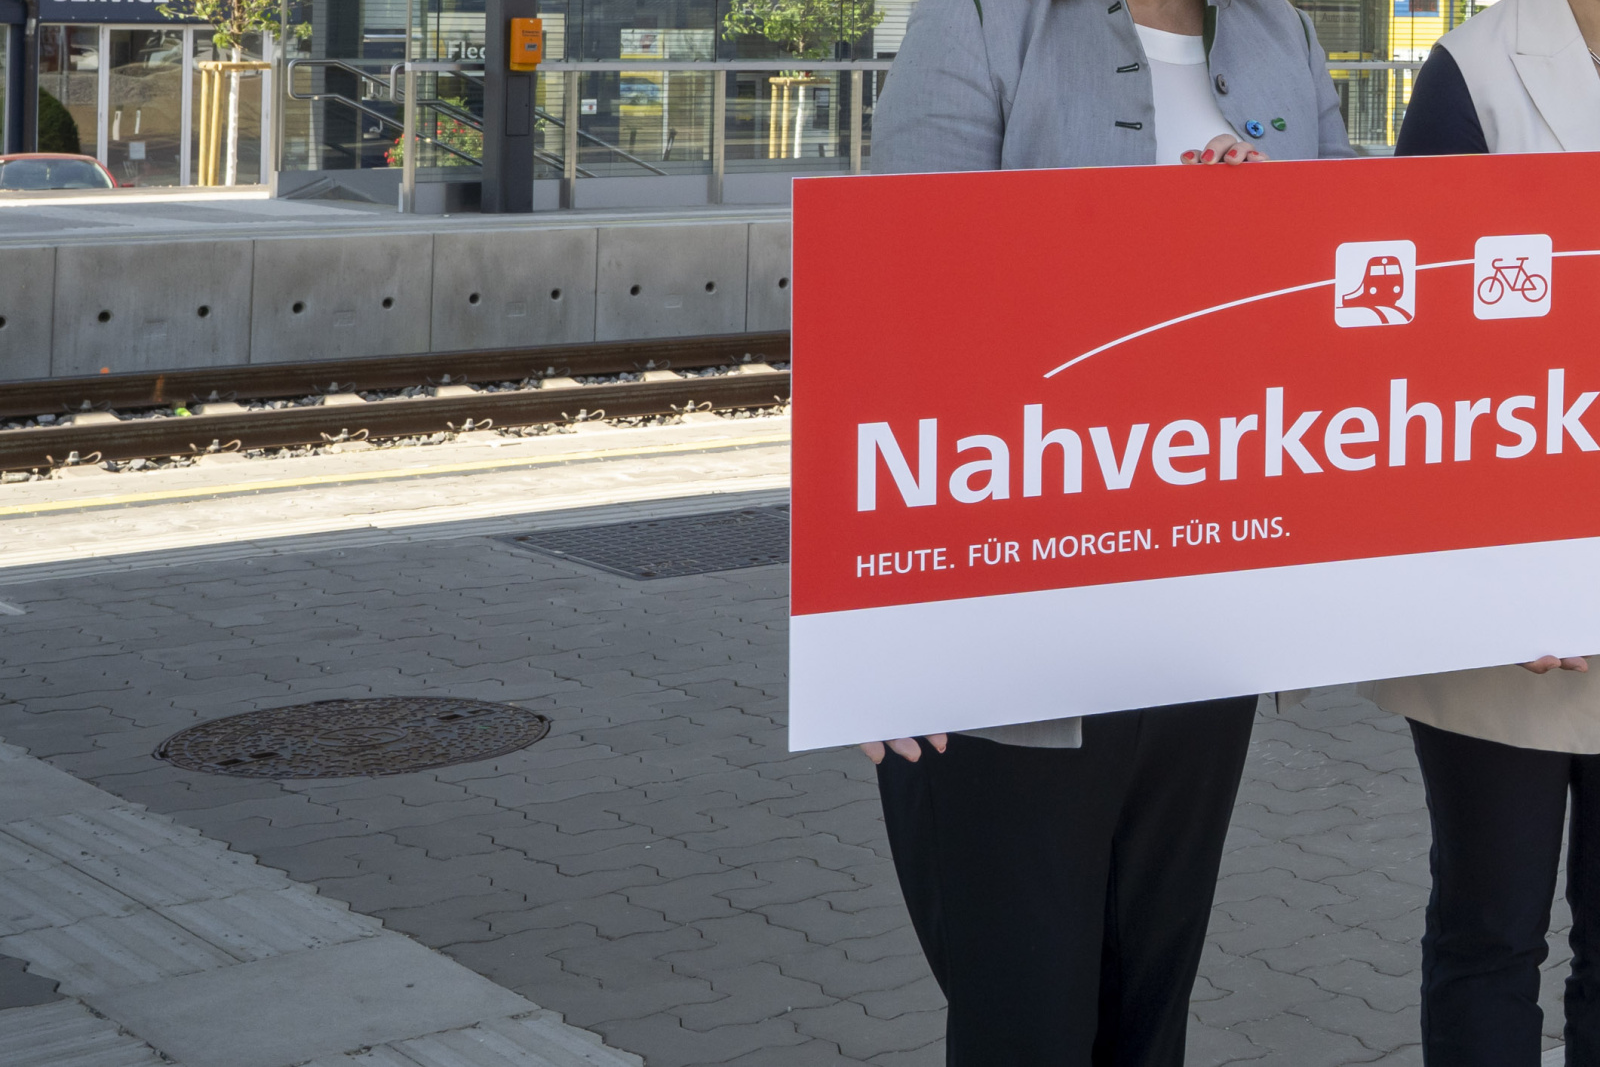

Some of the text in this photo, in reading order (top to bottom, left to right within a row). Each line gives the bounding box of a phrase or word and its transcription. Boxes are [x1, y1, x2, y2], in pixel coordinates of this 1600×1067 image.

[856, 516, 1291, 577] HEUTE. FÜR MORGEN. FÜR UNS.
